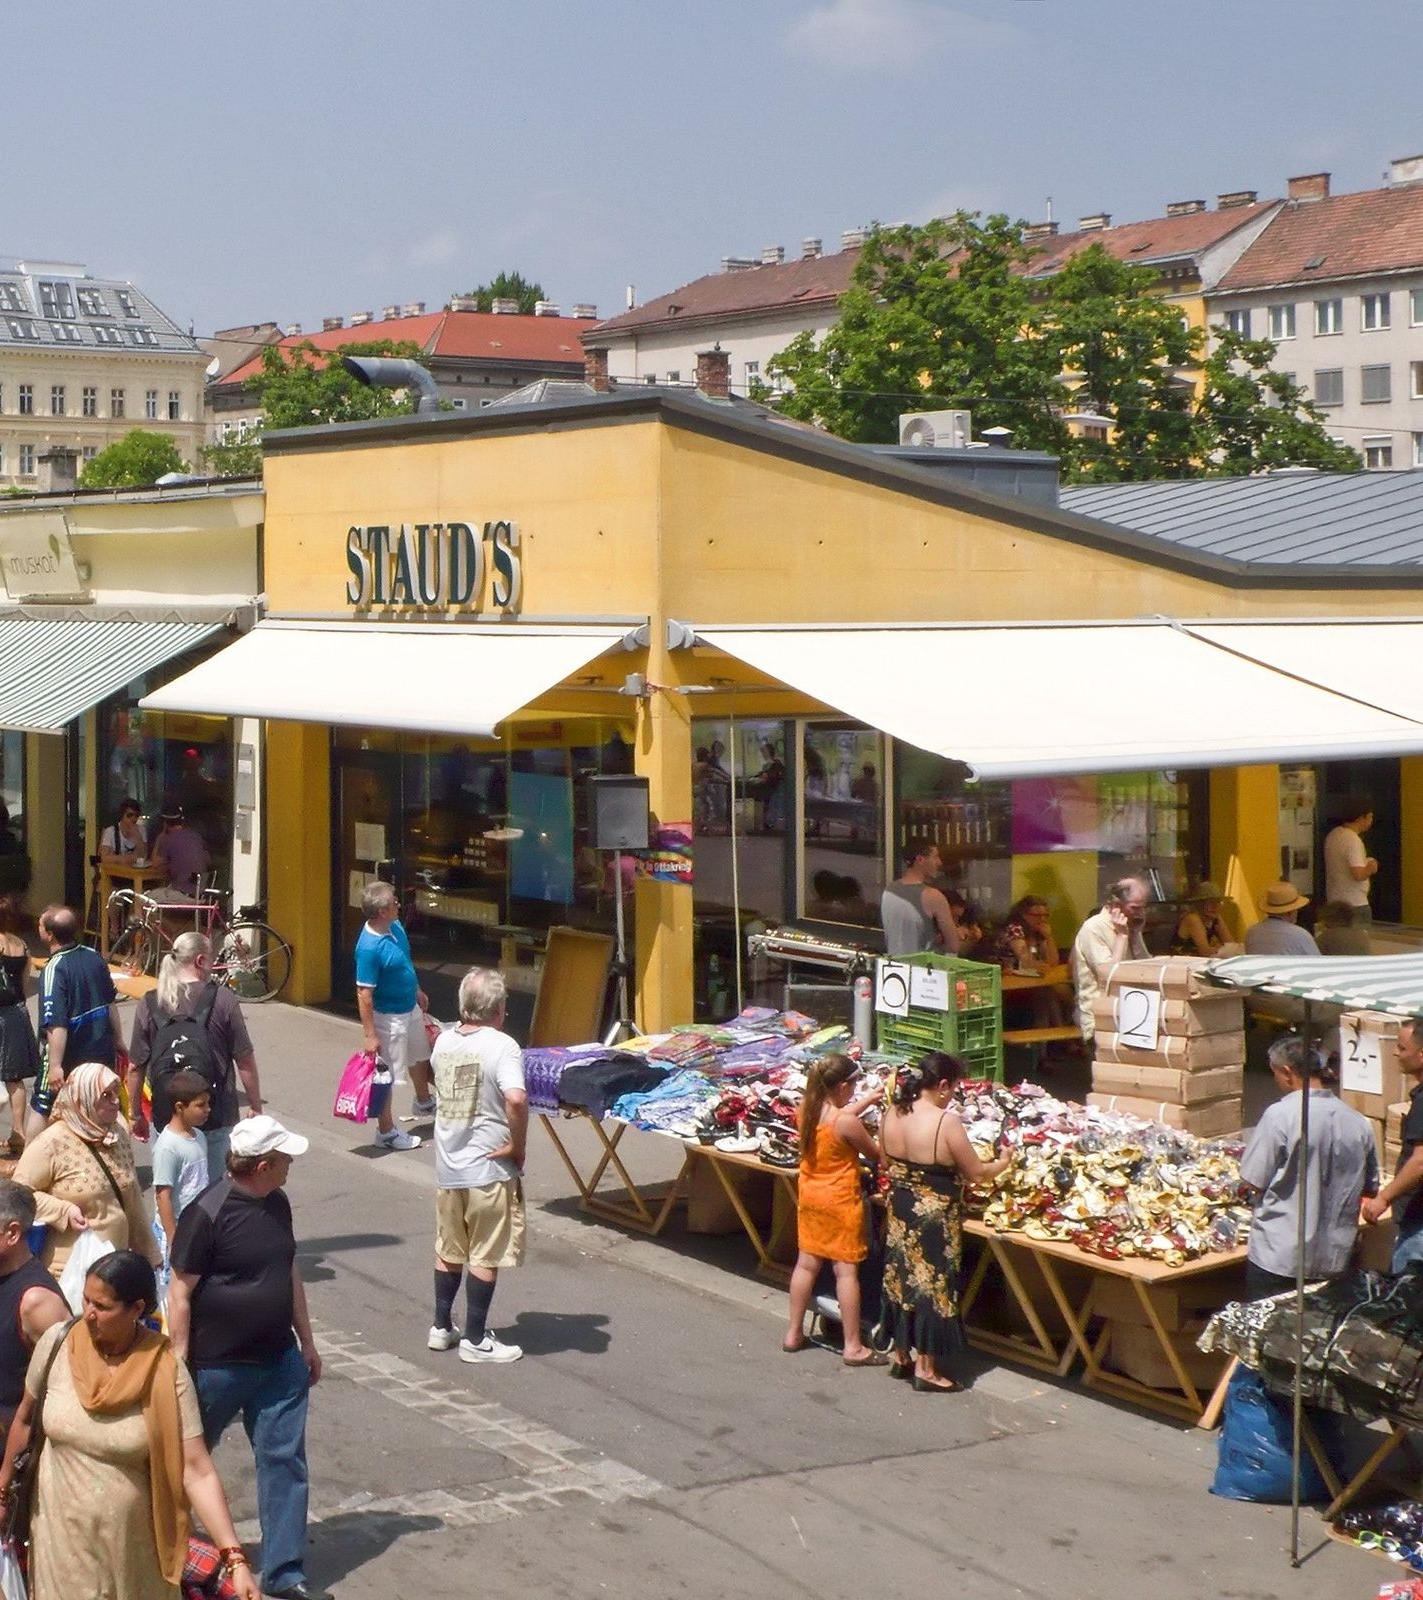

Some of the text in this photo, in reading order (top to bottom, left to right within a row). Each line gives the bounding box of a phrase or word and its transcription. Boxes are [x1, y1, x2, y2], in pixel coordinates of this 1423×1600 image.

[346, 520, 516, 608] STAUD'S
[882, 964, 907, 1009] 5
[336, 1097, 357, 1116] BIPA
